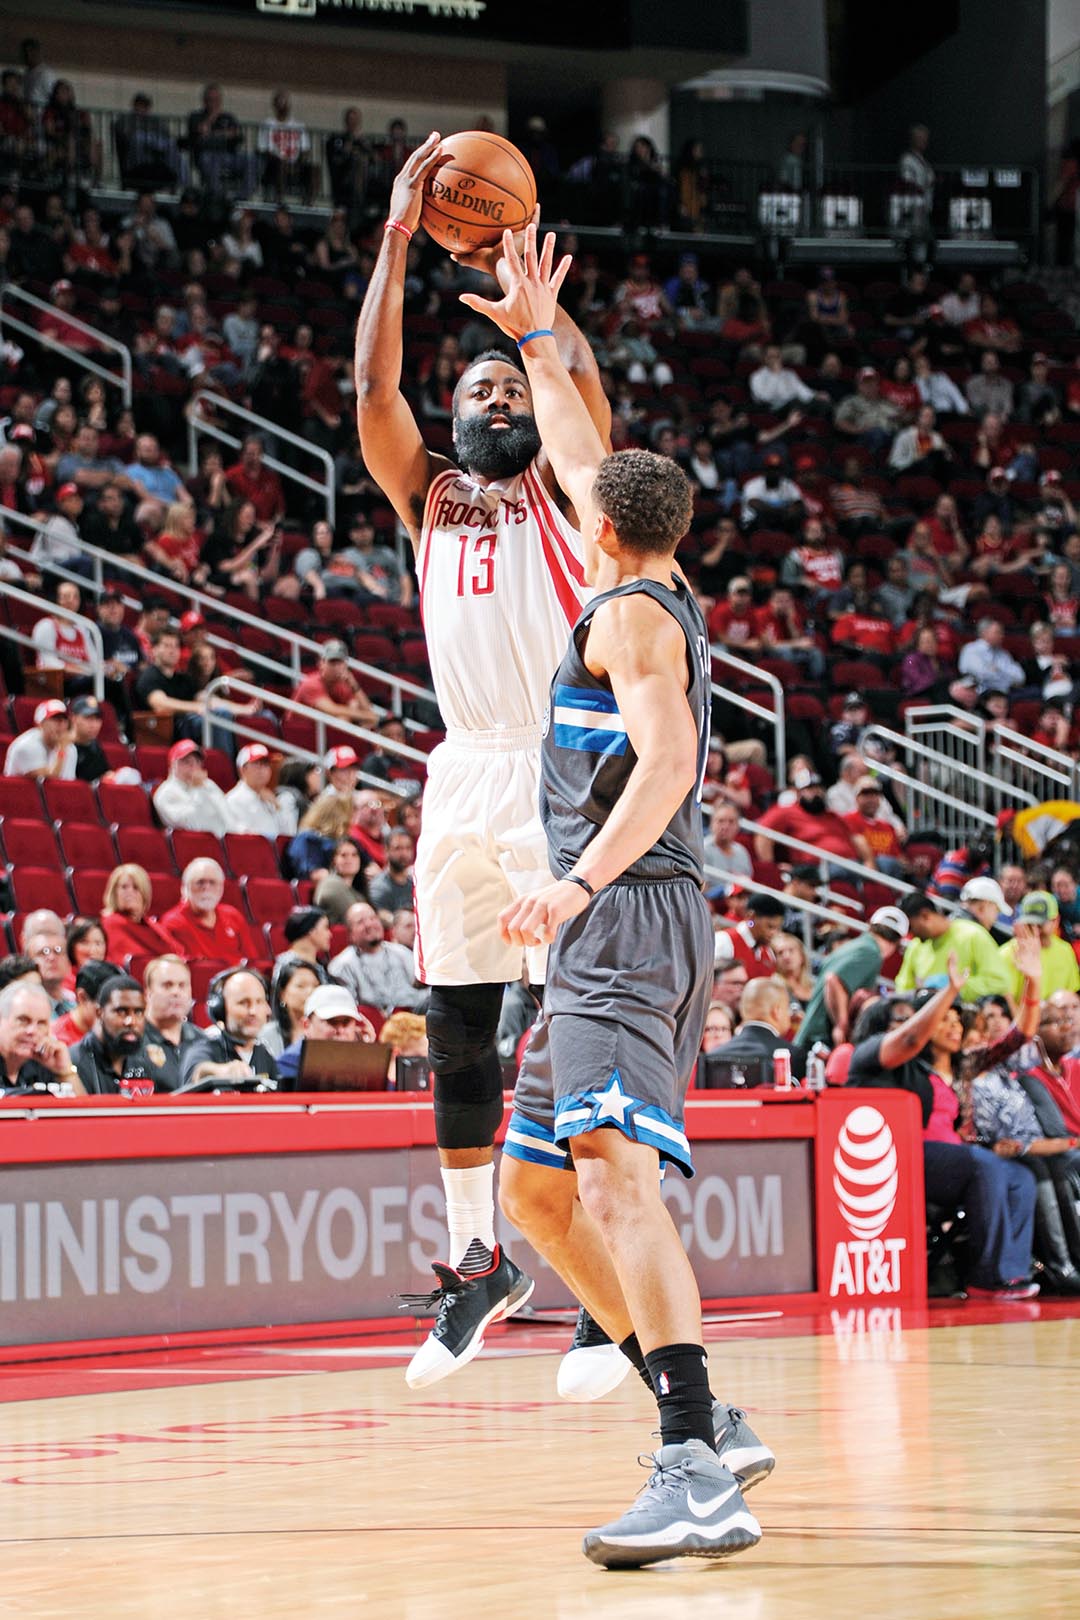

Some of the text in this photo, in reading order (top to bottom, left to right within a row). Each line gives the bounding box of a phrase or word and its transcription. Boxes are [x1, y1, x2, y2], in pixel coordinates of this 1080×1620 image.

[425, 176, 505, 222] SPALDING
[435, 496, 527, 532] ROCKTS
[456, 533, 498, 597] 13
[829, 1238, 907, 1297] AT&T
